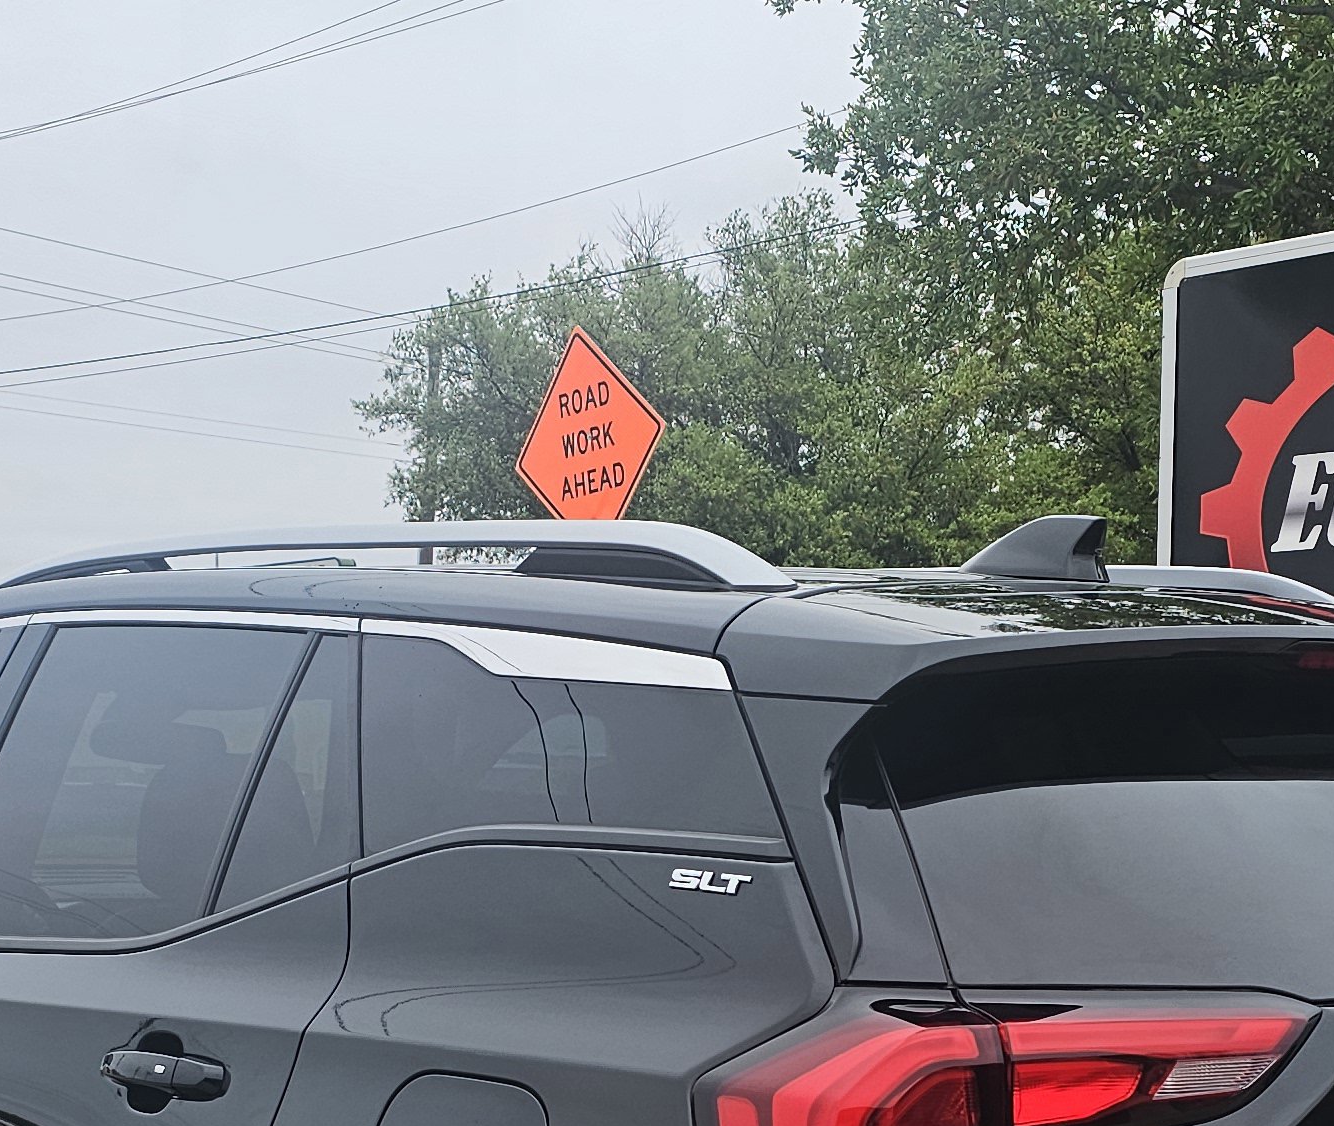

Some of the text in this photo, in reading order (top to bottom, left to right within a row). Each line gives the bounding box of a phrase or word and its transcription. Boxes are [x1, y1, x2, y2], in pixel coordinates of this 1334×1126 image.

[558, 380, 610, 418] ROAD
[561, 421, 615, 458] WORK
[561, 461, 625, 501] AHEAD
[668, 868, 753, 896] SLT
